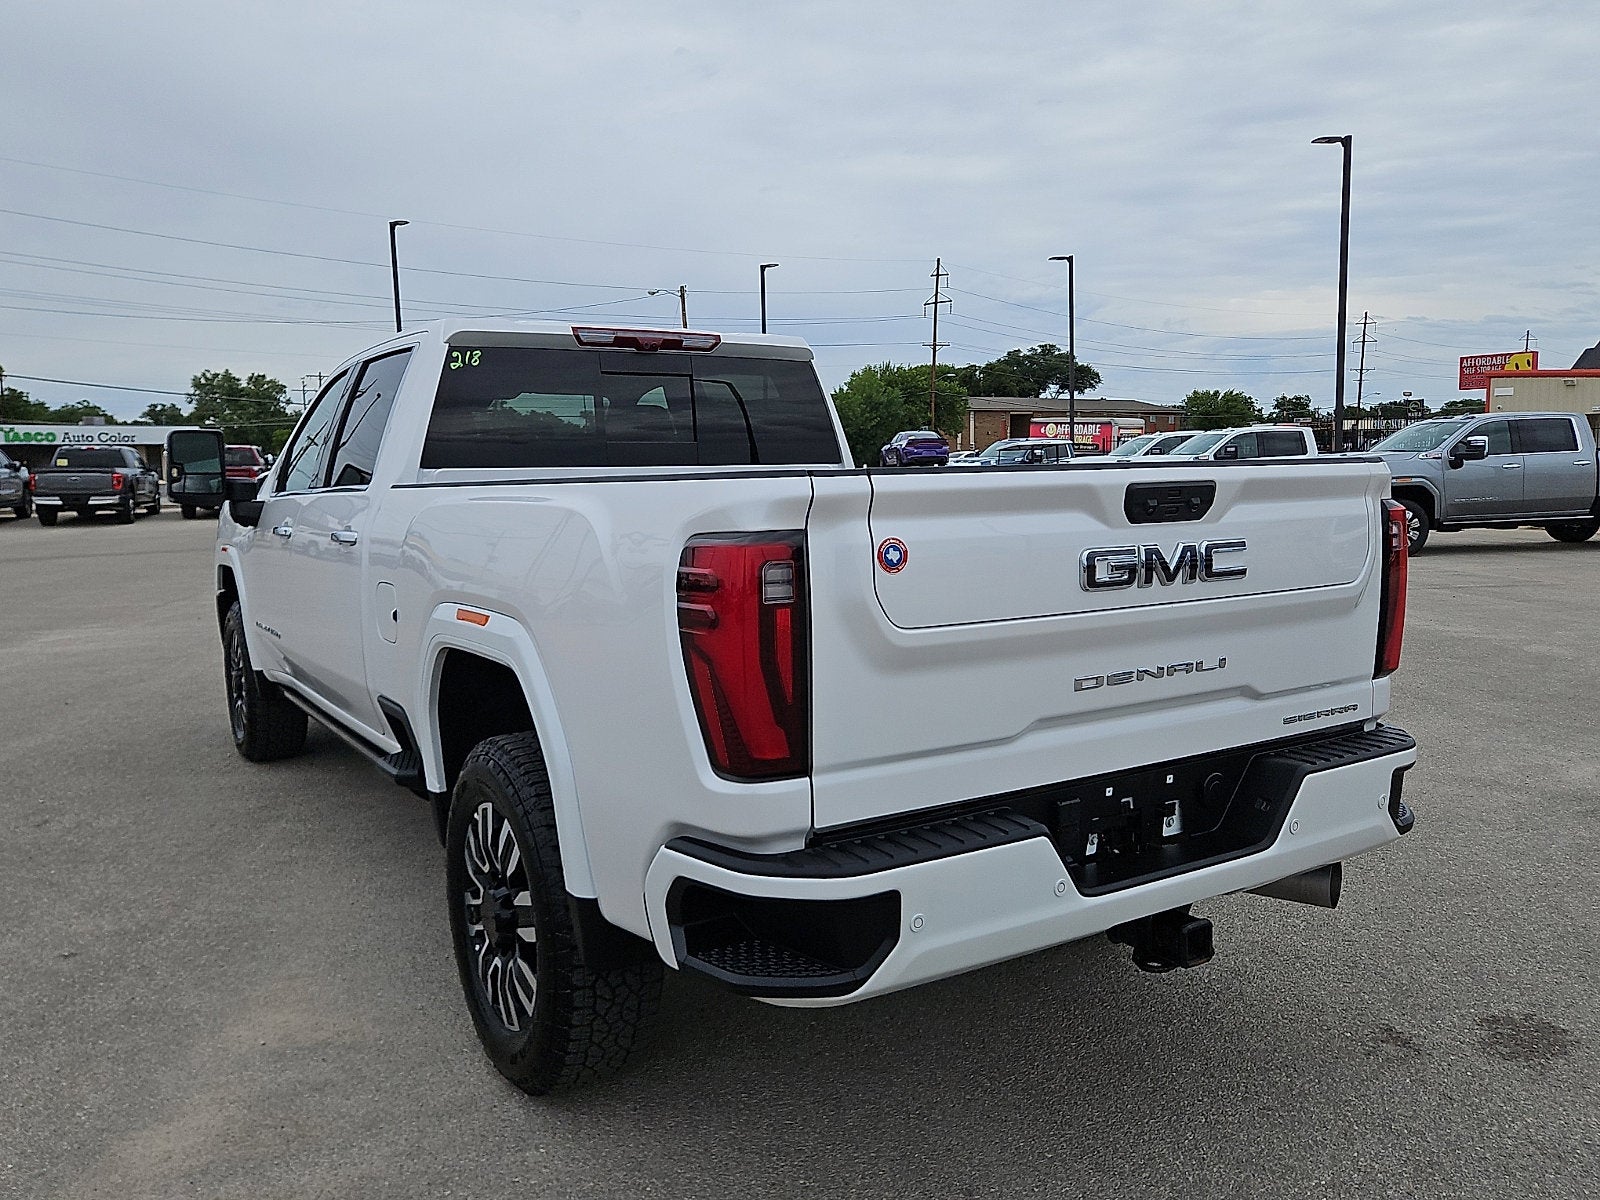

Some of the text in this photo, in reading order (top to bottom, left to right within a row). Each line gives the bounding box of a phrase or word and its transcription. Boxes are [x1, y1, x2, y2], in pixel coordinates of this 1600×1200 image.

[450, 350, 482, 370] 218
[1462, 356, 1511, 367] AFFORDABLE
[1463, 366, 1476, 375] SELF
[2, 428, 136, 443] TASCO Auto Color
[1057, 423, 1101, 435] AFFRDABLE
[1079, 538, 1248, 592] GMC
[1074, 655, 1227, 692] DENALI
[1282, 703, 1359, 725] SIERRA
